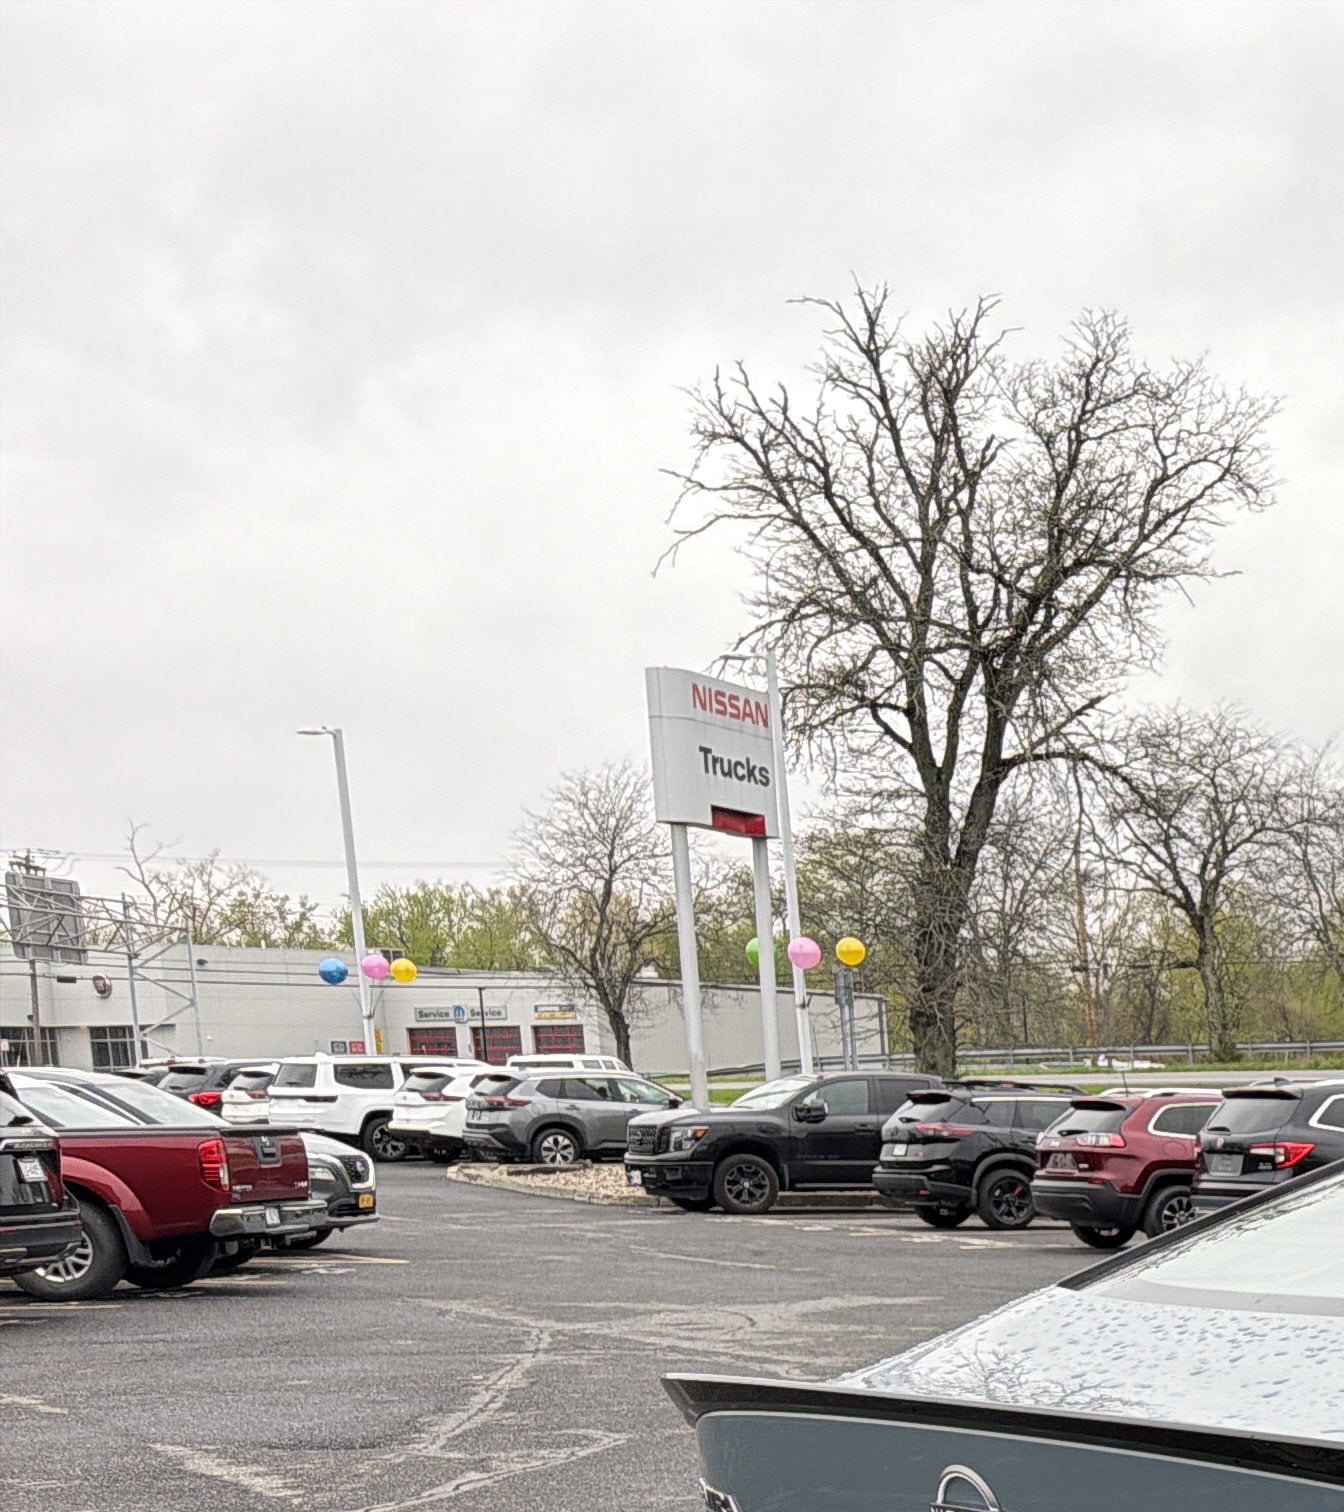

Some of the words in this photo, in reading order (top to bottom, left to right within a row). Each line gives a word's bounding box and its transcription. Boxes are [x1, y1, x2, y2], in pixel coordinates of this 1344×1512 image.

[692, 683, 769, 728] NISSAN
[699, 746, 770, 787] Trucks
[418, 1010, 450, 1018] Service
[470, 1008, 502, 1017] Sevice
